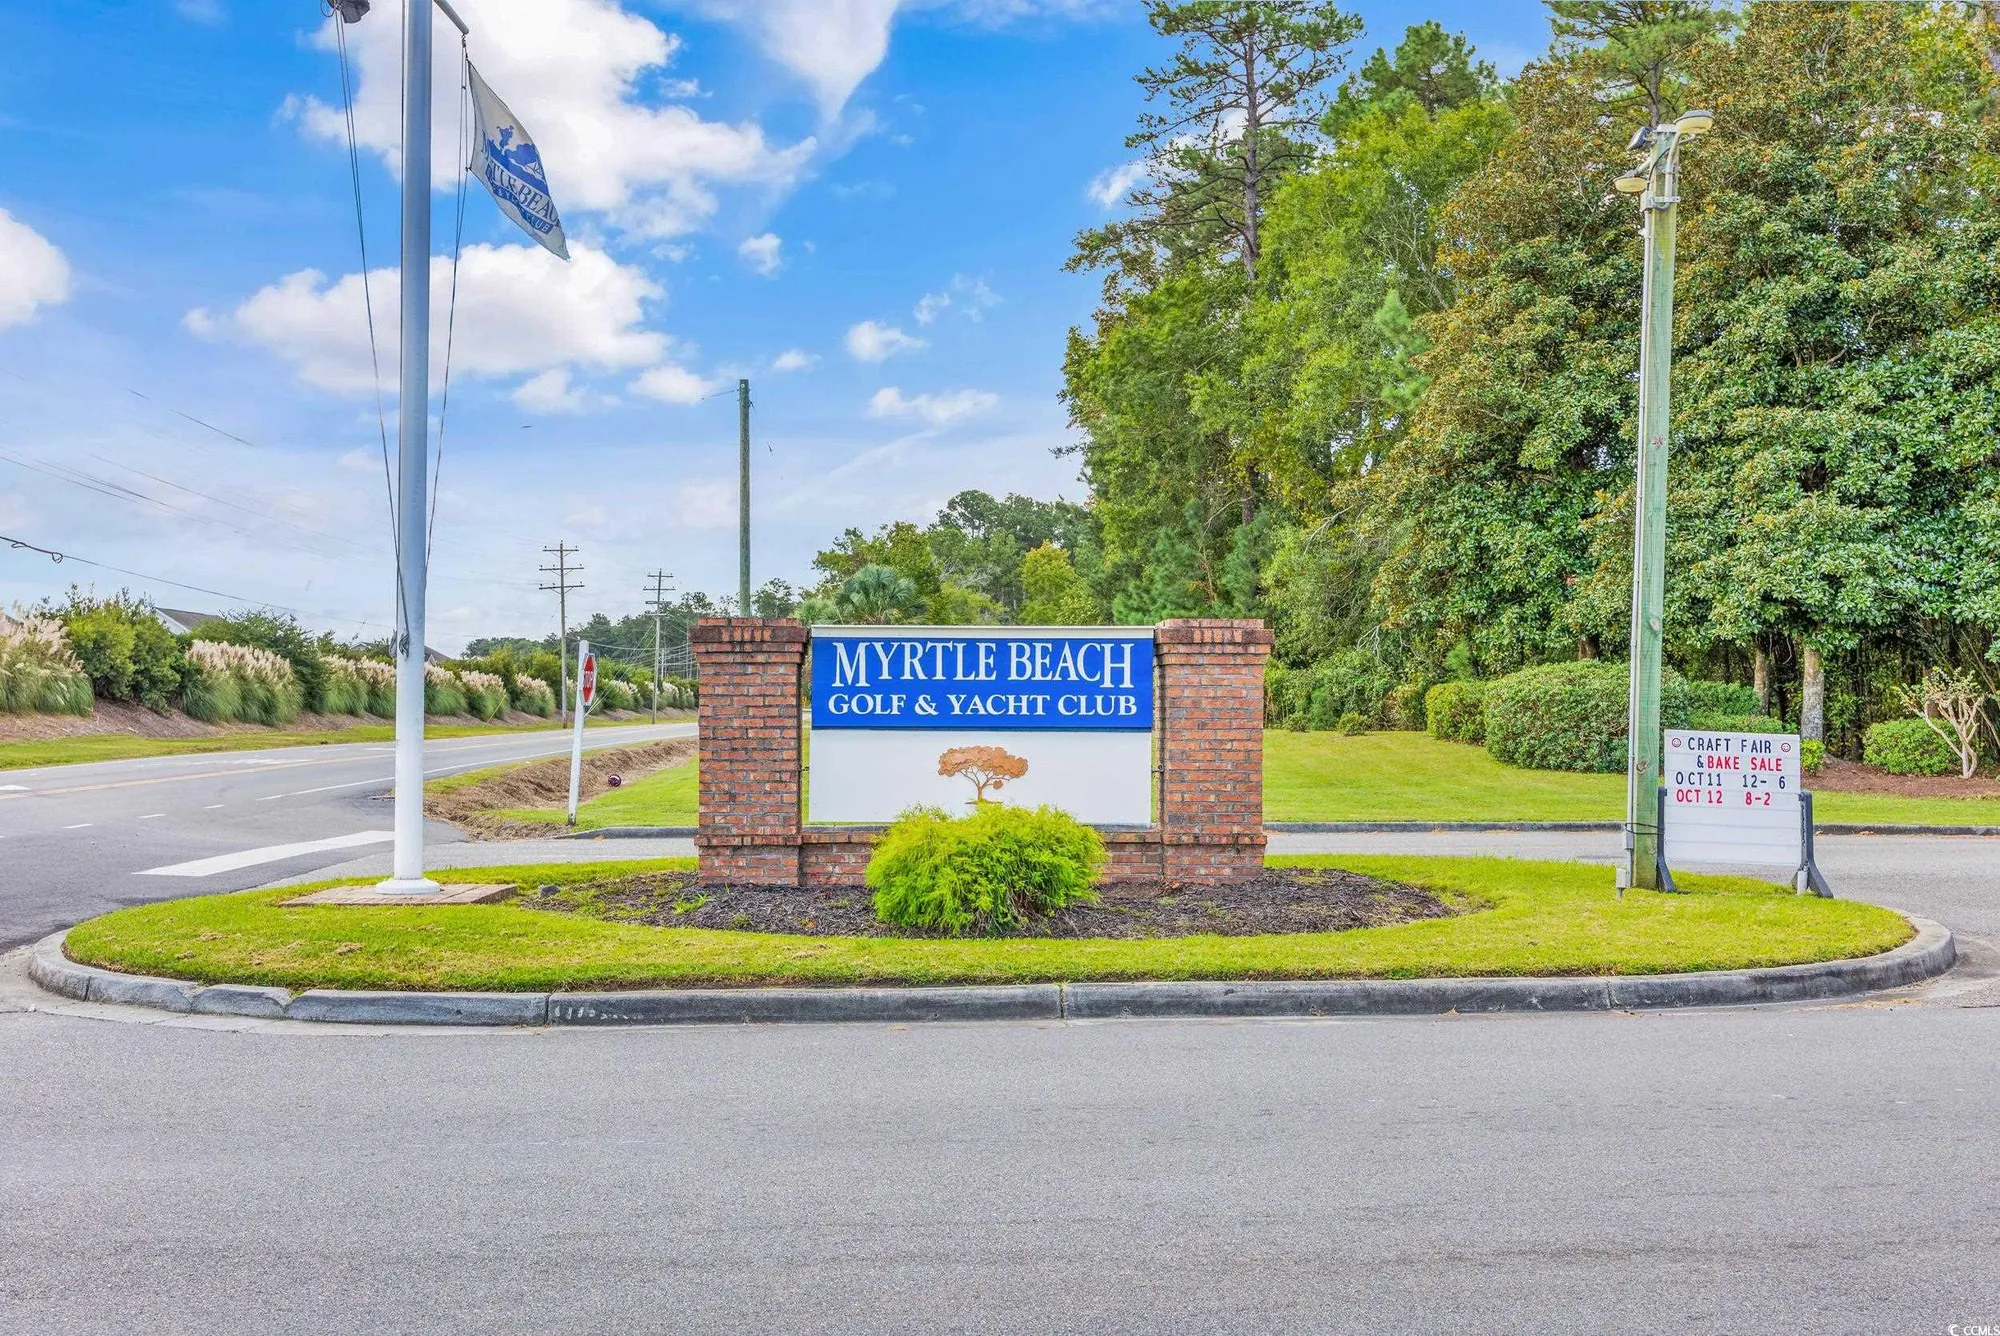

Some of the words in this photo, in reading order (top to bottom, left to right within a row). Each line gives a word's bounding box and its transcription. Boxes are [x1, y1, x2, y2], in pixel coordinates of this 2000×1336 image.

[831, 641, 997, 687] MYRTLE
[1008, 641, 1135, 689] BEACH
[828, 693, 906, 716] GOLF
[914, 694, 940, 716] &
[947, 694, 1050, 716] YACHT
[1057, 694, 1138, 717] CLUB
[1687, 737, 1731, 752] CRAFT
[1740, 739, 1772, 754] FAIR
[1750, 757, 1783, 772] SALE
[1676, 789, 1701, 803] OCT
[1707, 790, 1723, 804] 12
[1745, 791, 1771, 806] 8-2
